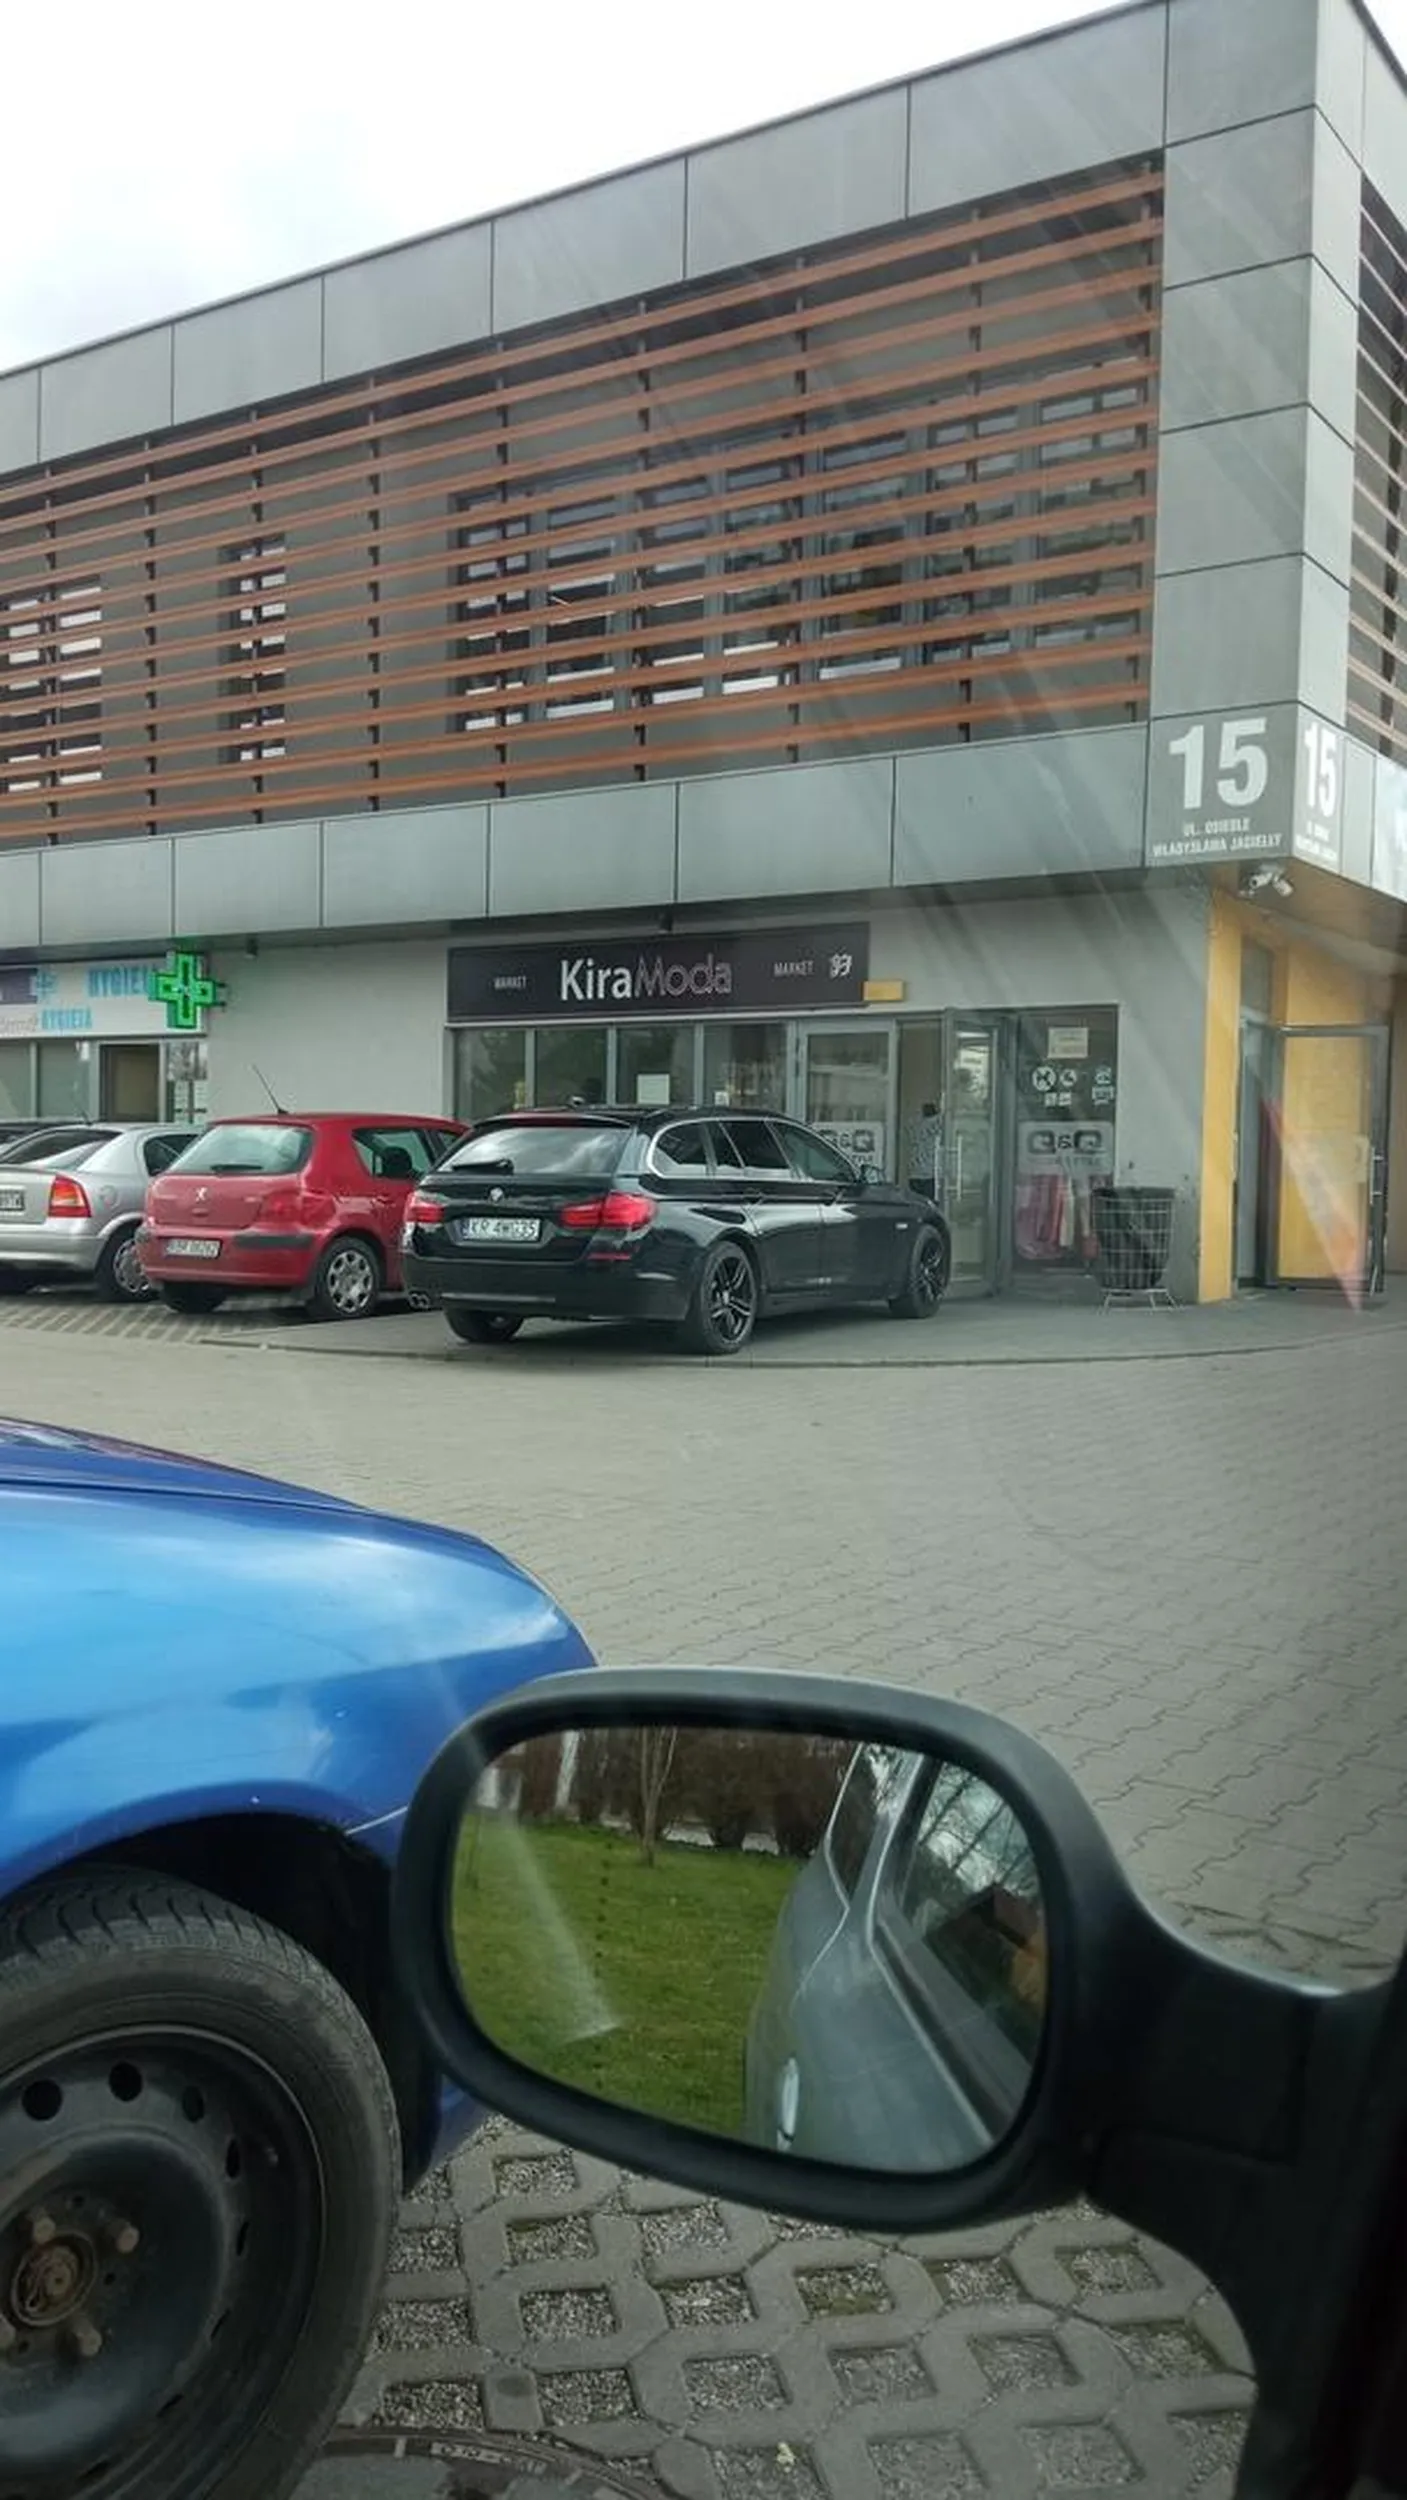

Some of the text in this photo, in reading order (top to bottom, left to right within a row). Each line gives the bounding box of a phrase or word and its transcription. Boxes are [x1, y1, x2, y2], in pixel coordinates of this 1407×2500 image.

[1169, 717, 1268, 810] 15
[1304, 722, 1336, 817] 15
[494, 975, 528, 990] MARKET
[560, 953, 732, 1001] KiraModa
[773, 960, 814, 978] MARKET
